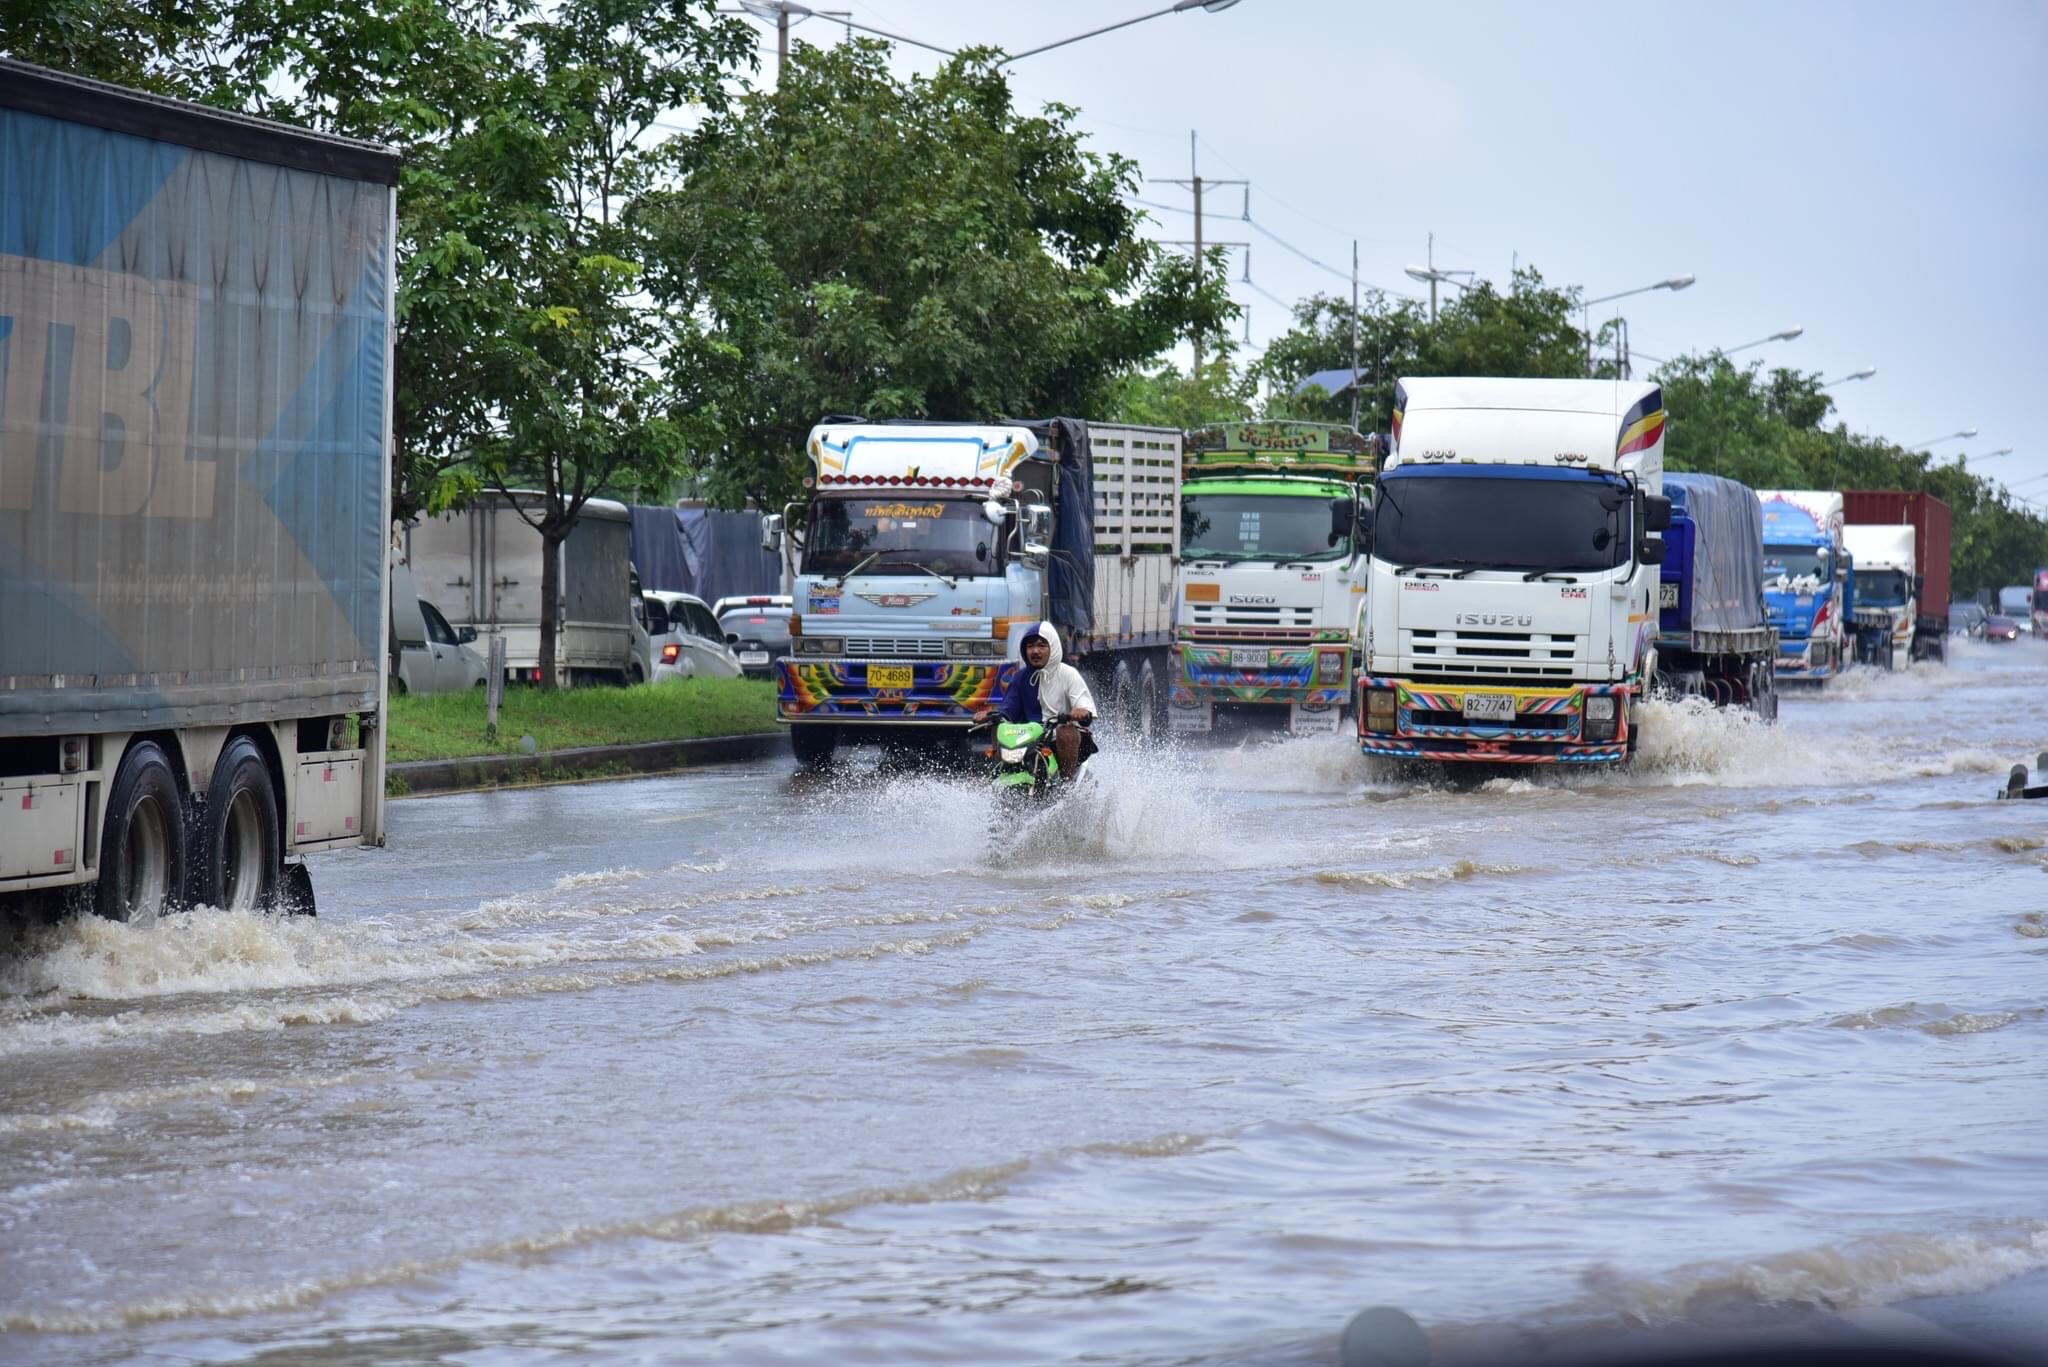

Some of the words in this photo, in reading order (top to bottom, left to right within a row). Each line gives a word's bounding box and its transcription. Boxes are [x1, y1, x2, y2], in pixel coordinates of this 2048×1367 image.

[0, 253, 217, 519] TBL
[96, 561, 133, 605] Thai
[1230, 595, 1276, 604] ISUZU
[1456, 613, 1532, 626] ISUZU
[870, 670, 911, 681] 70-4689
[1467, 699, 1513, 712] 82-7747
